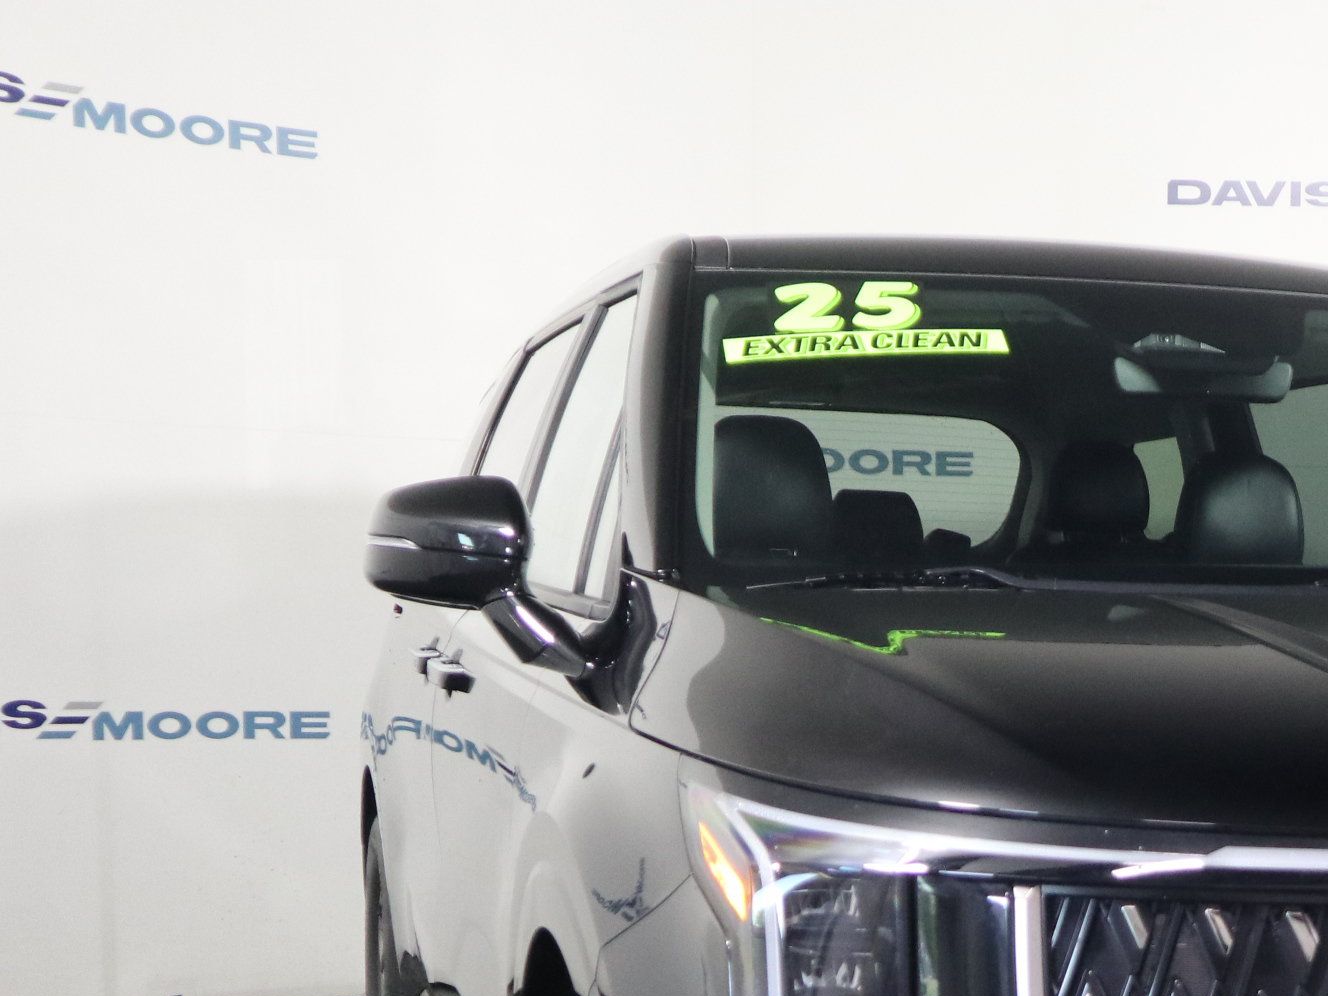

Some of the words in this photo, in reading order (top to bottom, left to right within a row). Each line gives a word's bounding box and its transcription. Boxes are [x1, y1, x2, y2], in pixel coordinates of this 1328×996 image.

[73, 97, 318, 159] MOORE
[773, 281, 922, 333] 25
[742, 333, 866, 358] EXTRA
[870, 330, 988, 351] CLEAN
[93, 710, 330, 741] MOORE
